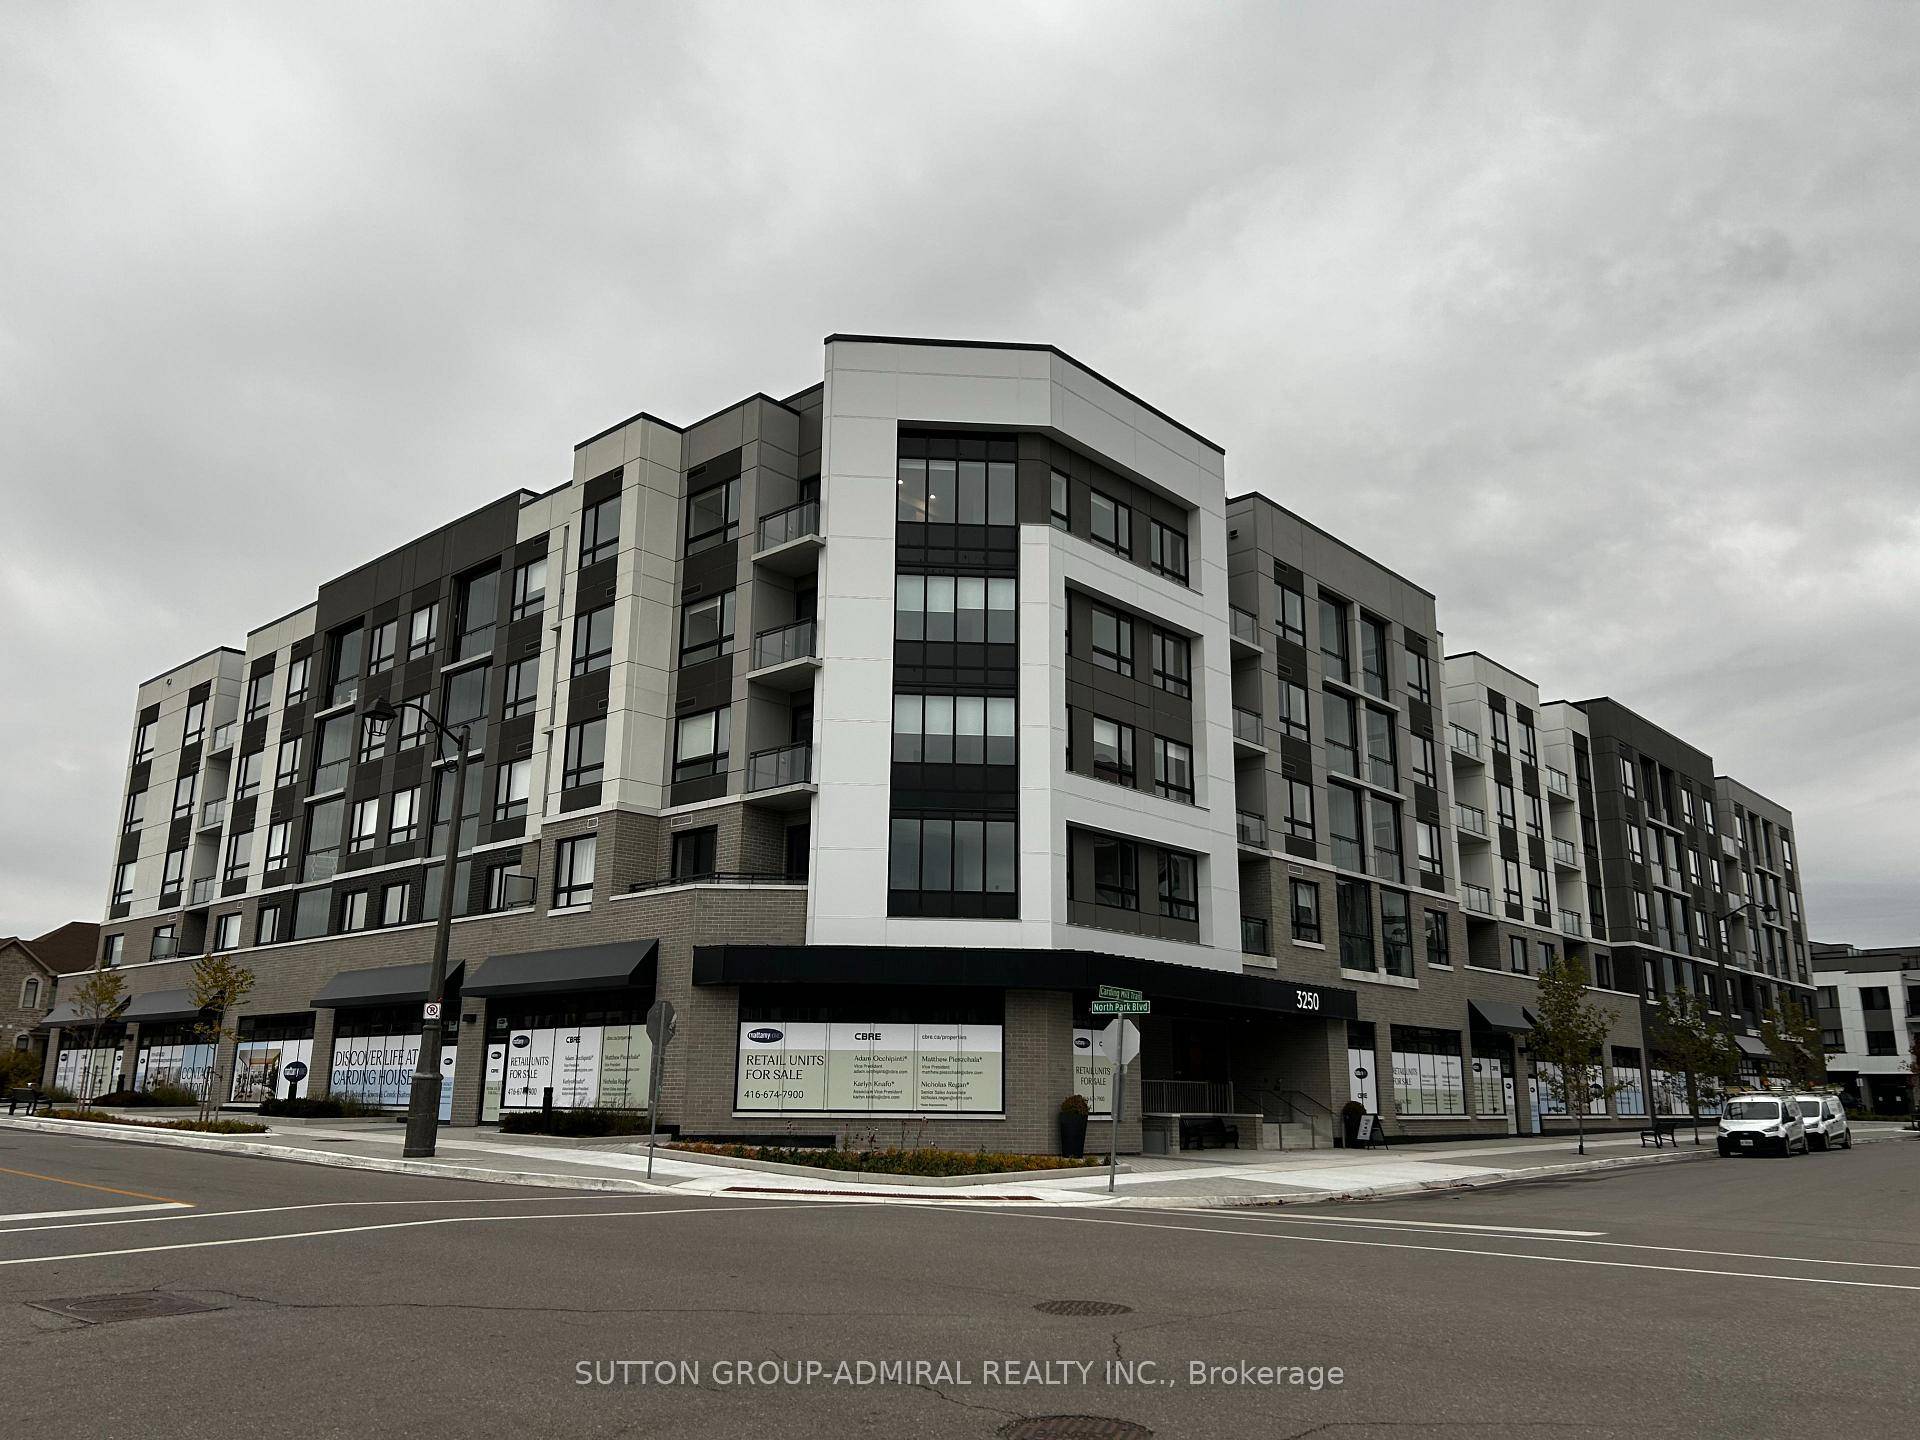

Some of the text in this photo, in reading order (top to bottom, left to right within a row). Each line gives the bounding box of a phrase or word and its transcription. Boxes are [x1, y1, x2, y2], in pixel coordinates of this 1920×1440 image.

[1101, 987, 1141, 1000] Carding Mill Trail
[1296, 990, 1319, 1010] 3250
[1094, 1003, 1148, 1012] North Park Blvd
[854, 1032, 882, 1041] CBRE
[335, 1048, 418, 1066] DISCOVER LIFE AT
[510, 1056, 550, 1066] RETAIL UNITS
[746, 1055, 824, 1066] RETAIL UNITS
[510, 1070, 522, 1078] FOR
[746, 1070, 803, 1080] FOR SALE
[1094, 1066, 1110, 1076] UNITS
[333, 1068, 413, 1086] CARDING HOUSE
[1080, 1077, 1093, 1086] FOR
[744, 1090, 804, 1099] 416-674-7900
